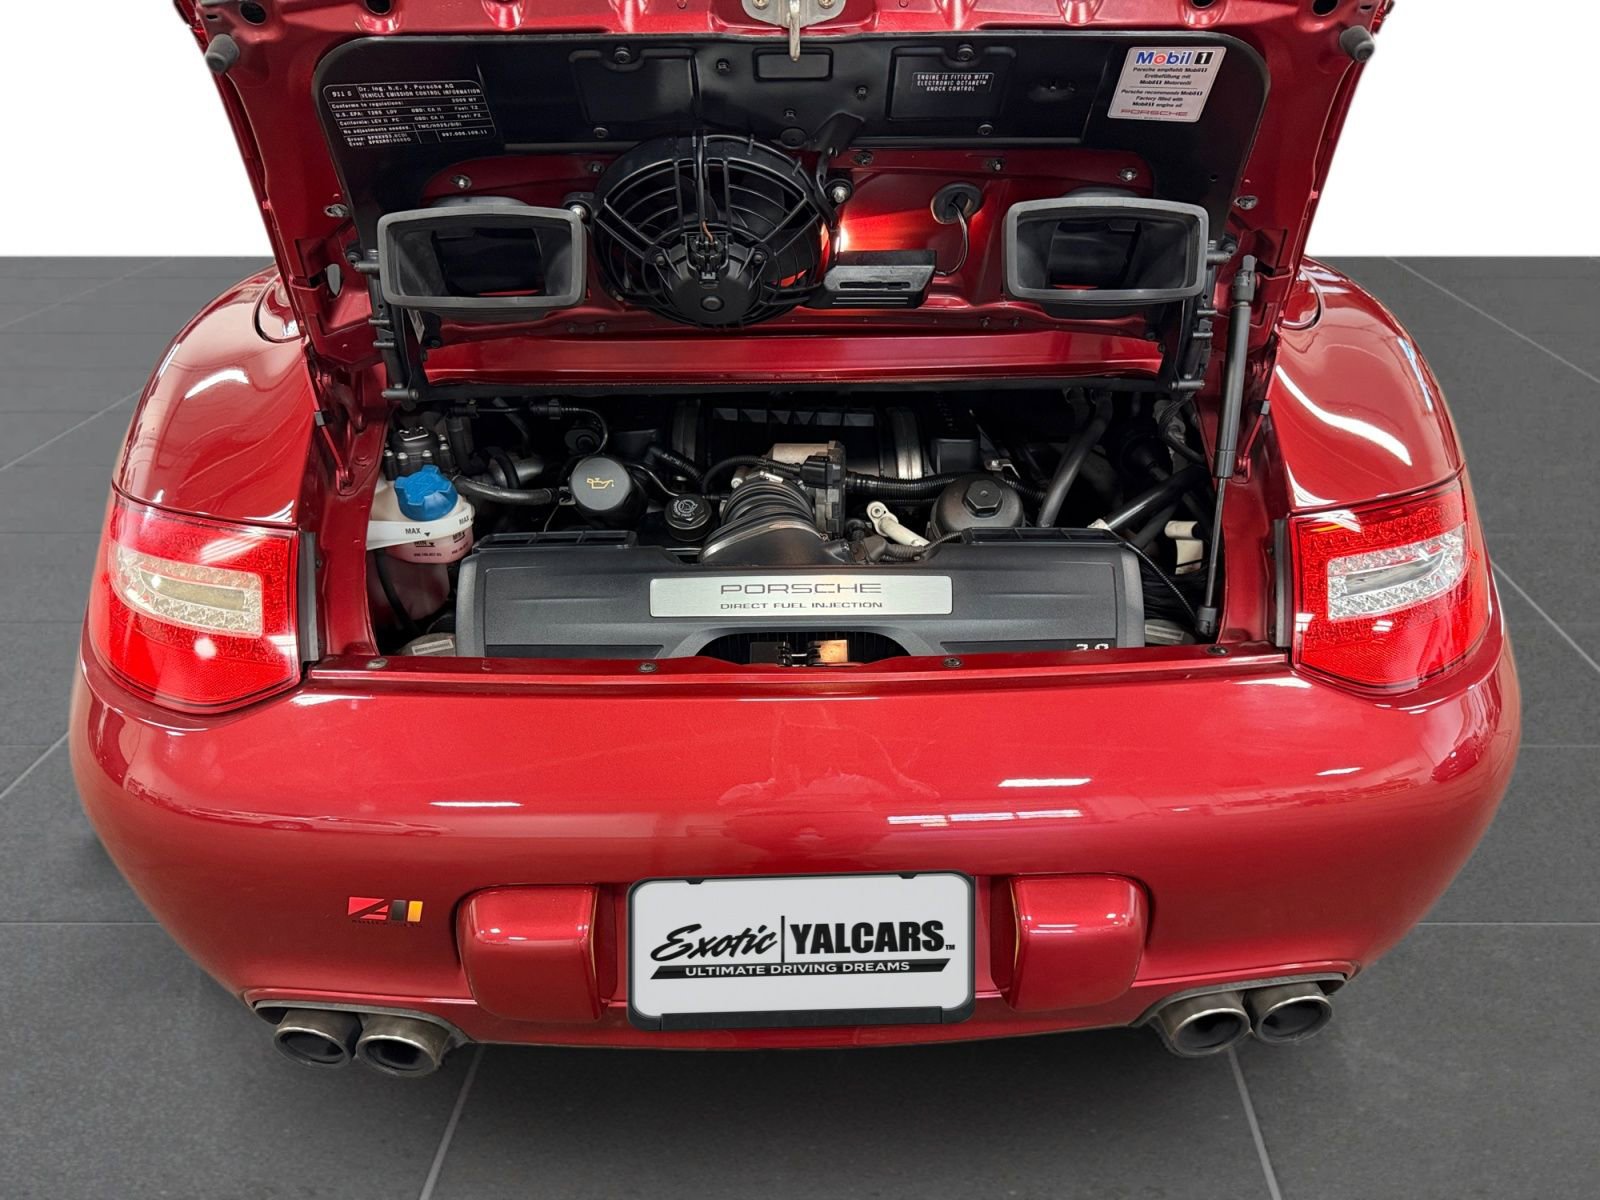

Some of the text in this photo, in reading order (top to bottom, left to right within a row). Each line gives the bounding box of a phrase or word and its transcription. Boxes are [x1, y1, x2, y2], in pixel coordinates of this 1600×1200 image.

[1135, 51, 1193, 65] Mobil
[458, 515, 470, 525] MAX
[720, 583, 882, 595] PORSCHE
[720, 602, 769, 610] DIRECT
[811, 601, 883, 609] INJECTION
[650, 923, 778, 962] Exotic
[685, 961, 910, 977] ULTIMATE DRIVING DREAMS
